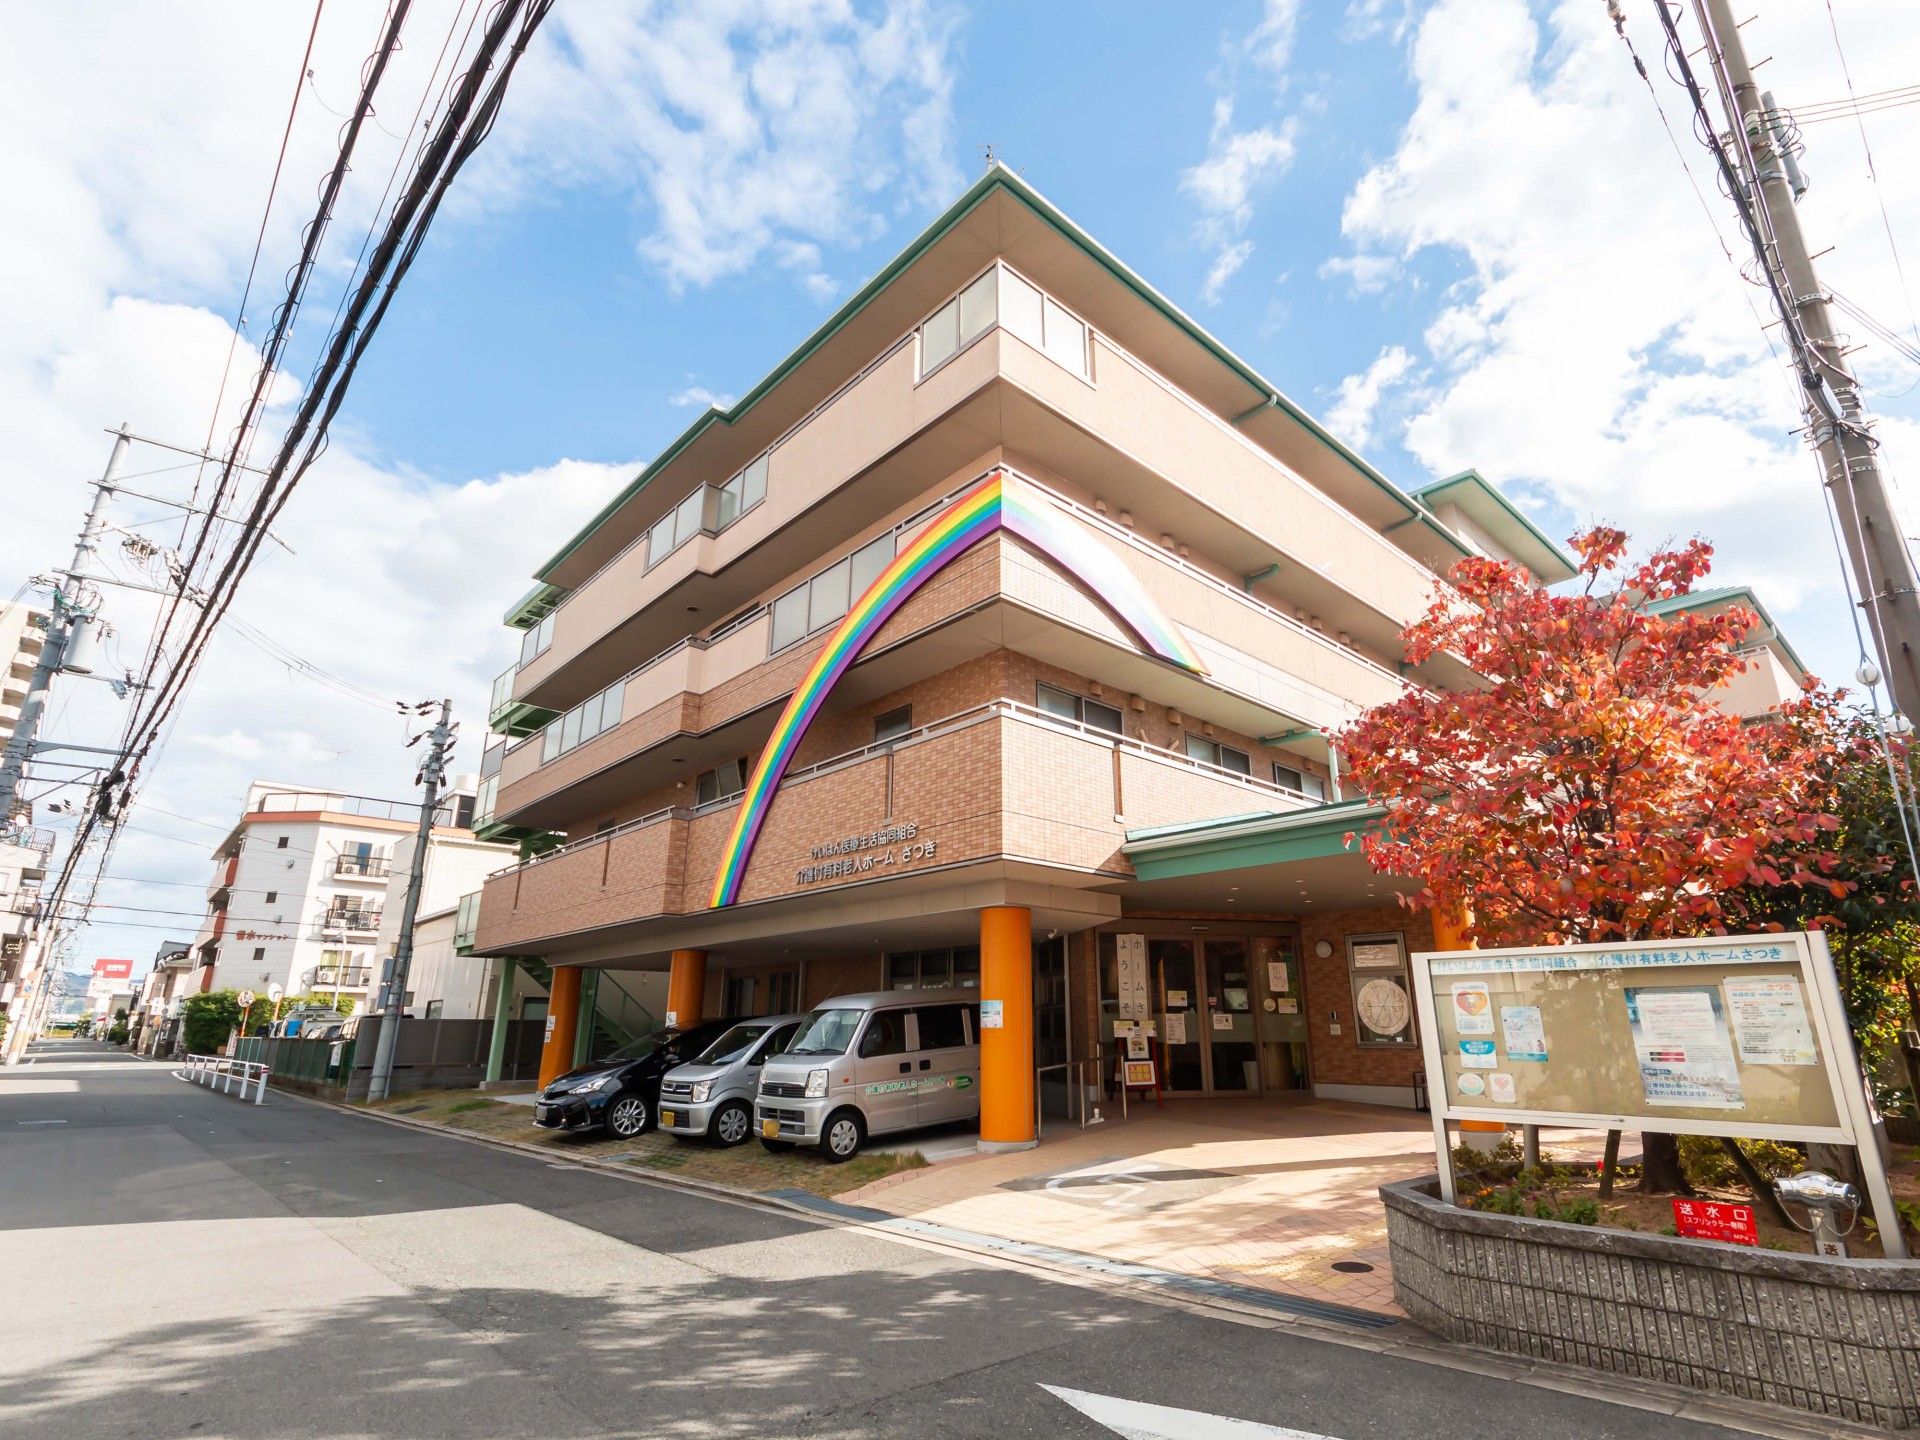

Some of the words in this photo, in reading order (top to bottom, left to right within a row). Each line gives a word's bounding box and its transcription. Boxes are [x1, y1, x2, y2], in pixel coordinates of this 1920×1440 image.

[811, 823, 917, 859] けいはん医療生活協同組合
[796, 849, 894, 885] 介護付有料老人ホーム
[902, 840, 937, 863] さつき
[1598, 947, 1783, 966] 介護付有料老人ホームさつき
[1120, 940, 1131, 1013] ようこそ
[1680, 1203, 1748, 1221] 送水口
